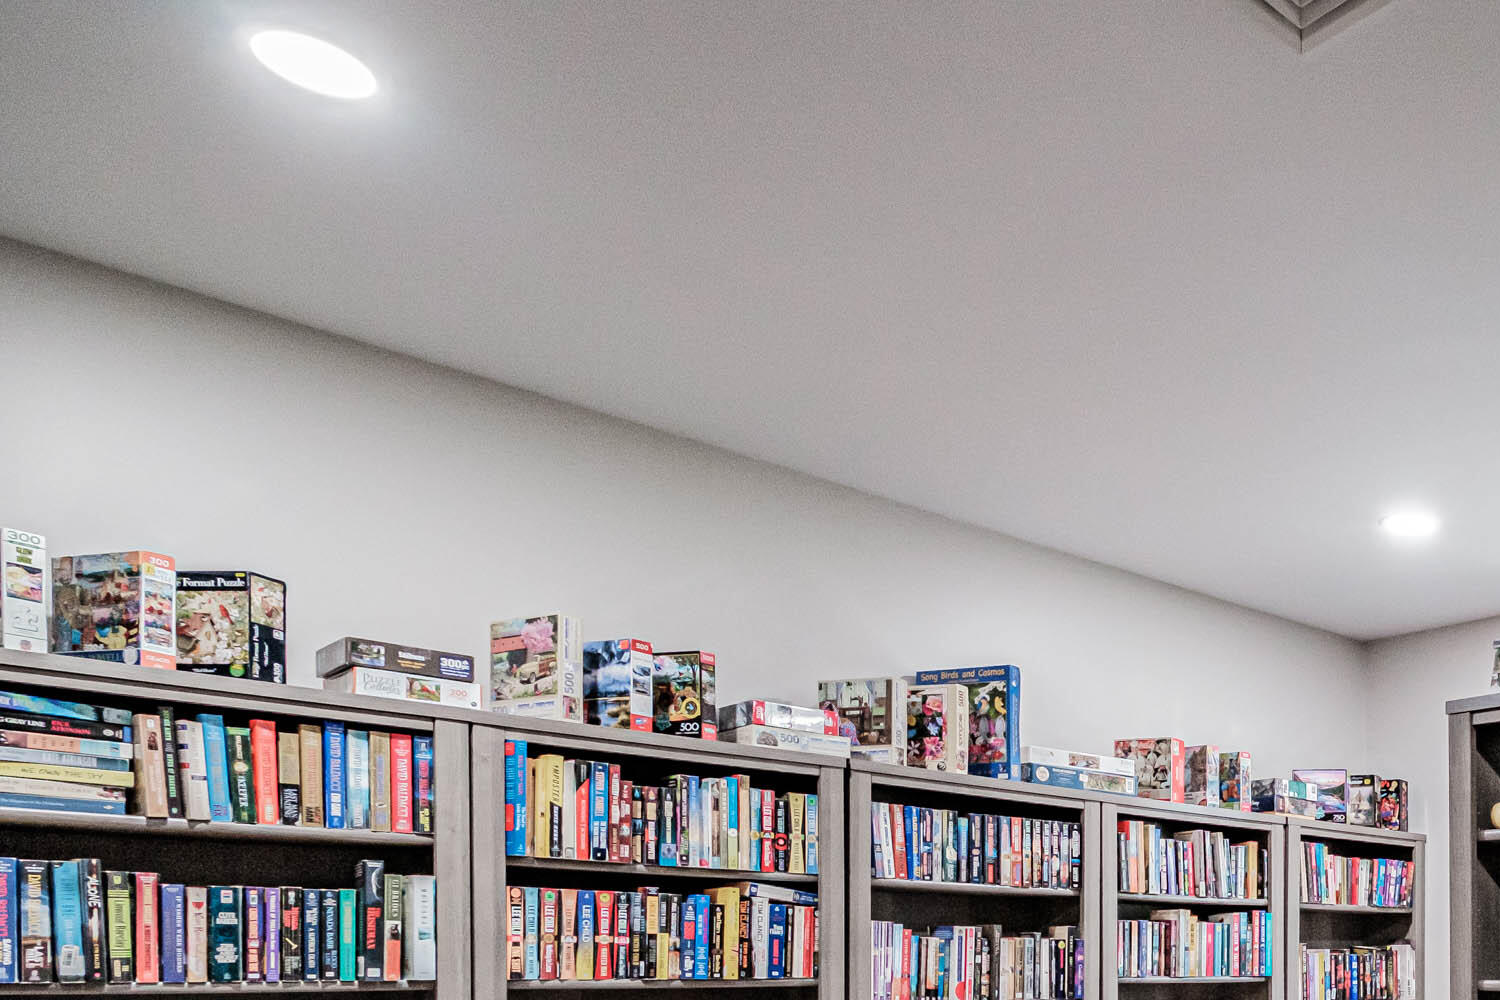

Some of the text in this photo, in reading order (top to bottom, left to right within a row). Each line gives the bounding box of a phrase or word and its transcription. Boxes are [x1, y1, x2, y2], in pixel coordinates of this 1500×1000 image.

[8, 530, 42, 545] 300
[149, 556, 170, 568] 300
[182, 576, 245, 587] Format Puzzle
[635, 642, 649, 651] 500
[441, 657, 461, 669] 300
[920, 668, 1006, 682] Song Birds and Cosmos
[564, 672, 575, 694] 500
[679, 722, 699, 731] 500
[780, 733, 799, 744] 500
[330, 737, 340, 757] DAVID
[237, 779, 248, 807] KEEPER
[397, 759, 408, 817] DAVID BALDACCI
[213, 804, 221, 817] FIX
[1332, 814, 1345, 822] 750
[28, 874, 41, 898] DAVID
[391, 879, 400, 918] GI BRIDES
[511, 906, 521, 917] LEE
[545, 905, 554, 933] LEE CHILD
[601, 907, 609, 917] LEE
[618, 909, 627, 918] LEE
[326, 906, 335, 949] NEVADA BARR
[527, 916, 535, 932] CHILD
[582, 904, 591, 942] LEE CHILD
[739, 901, 747, 939] TOM CLANCY
[366, 907, 377, 950] IRISHMAN
